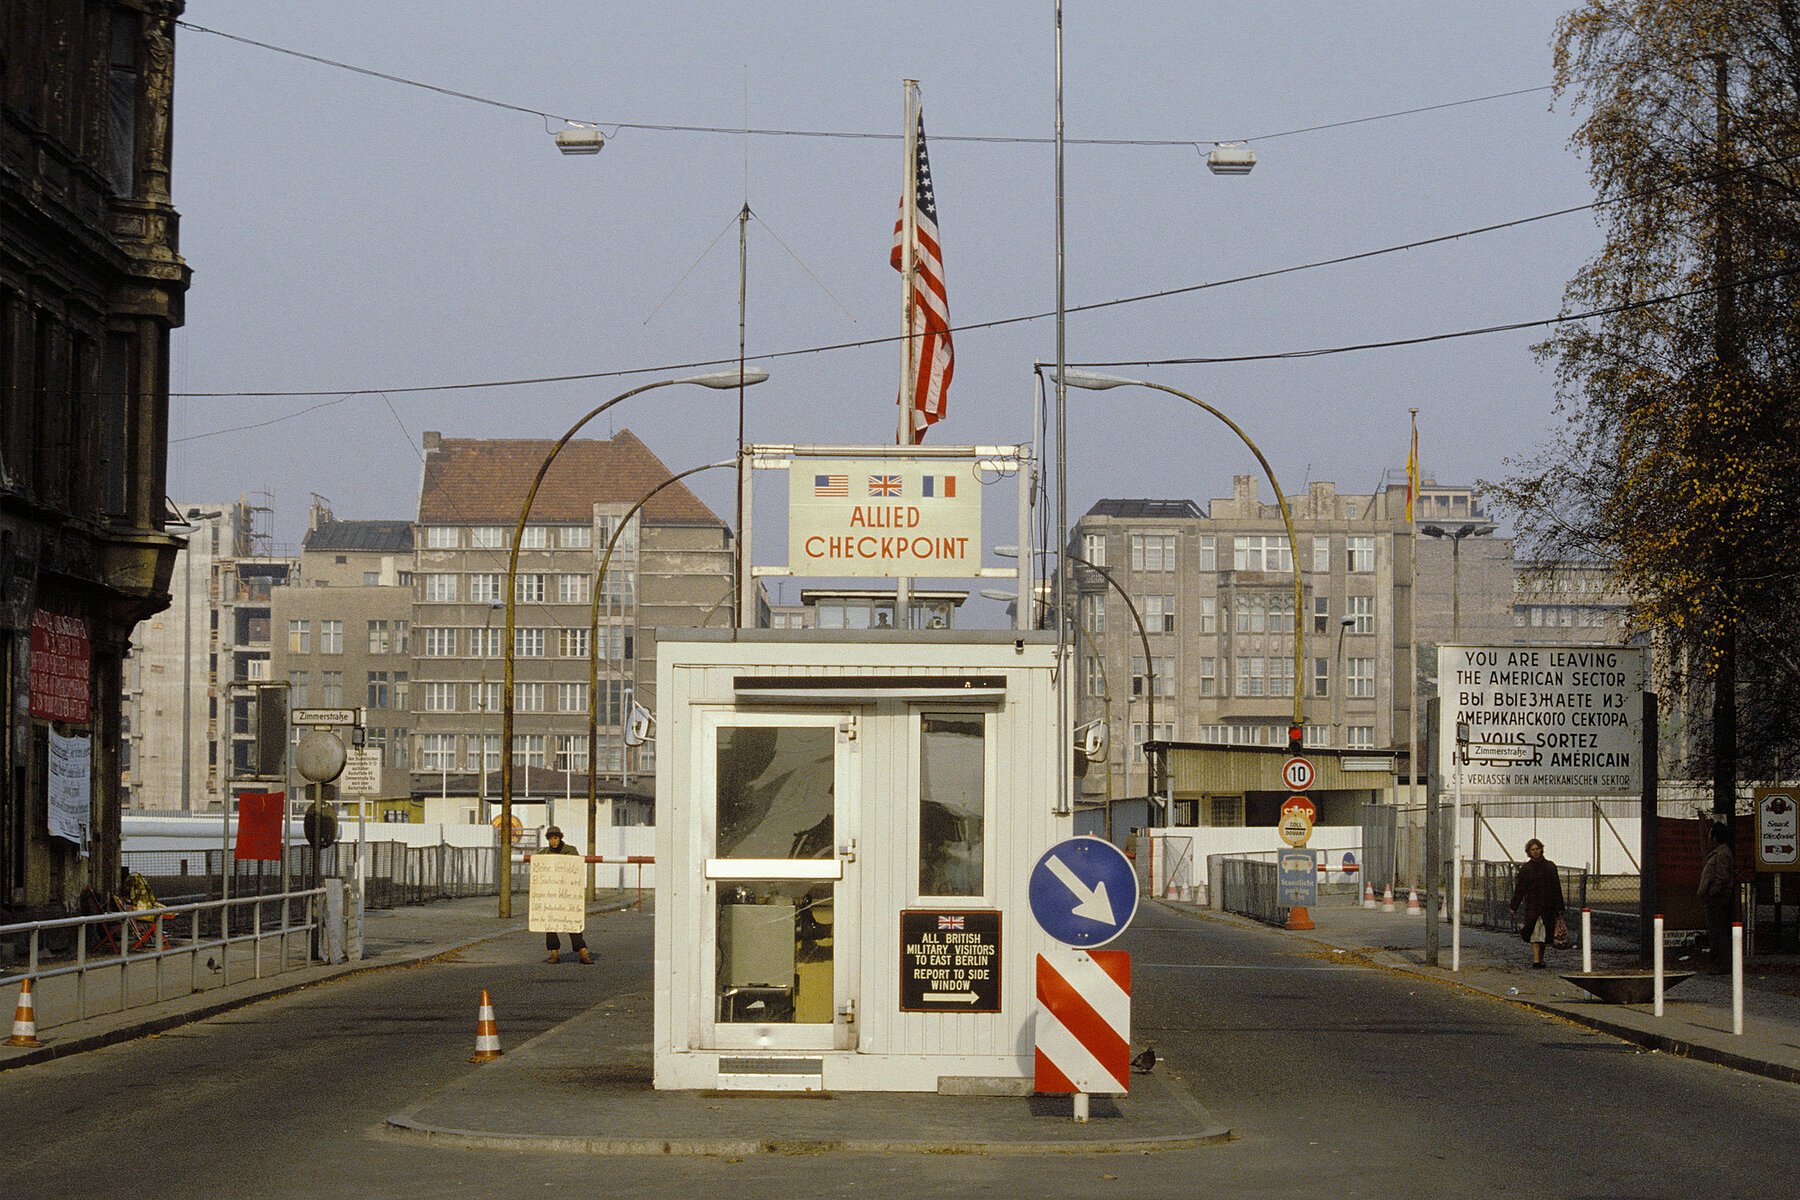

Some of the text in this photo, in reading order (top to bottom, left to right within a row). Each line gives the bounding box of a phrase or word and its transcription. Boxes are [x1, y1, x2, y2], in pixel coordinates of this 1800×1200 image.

[849, 505, 920, 528] ALLIED
[804, 535, 969, 560] CHECKPOINT
[1465, 651, 1618, 668] YOU ARE LEAVING
[1456, 670, 1626, 687] THE AMERICAN SECTOR
[1459, 691, 1624, 708] ВЫ ВЫЕЗЖАЕТЕ ИЗ
[299, 711, 349, 722] Zimmerstraße
[1456, 710, 1629, 727] АМЕРИКАНСКОГО СЕКТОРА
[1480, 732, 1598, 748] VOUS SORTEZ
[1474, 745, 1527, 758] Zimmerstraße
[1550, 749, 1630, 767] AMÉRICAIN
[1291, 766, 1306, 782] 10
[1452, 773, 1630, 786] SE VERLASSEN DEN AMERIKANISCHEN SEKTOR
[922, 933, 981, 944] ALL BRITISH
[906, 944, 995, 956] MILITARY VISITORS
[915, 955, 988, 966] TO EAST BERLIN
[913, 968, 990, 980] REPORT TO SIDE
[931, 980, 971, 991] WINDOW
